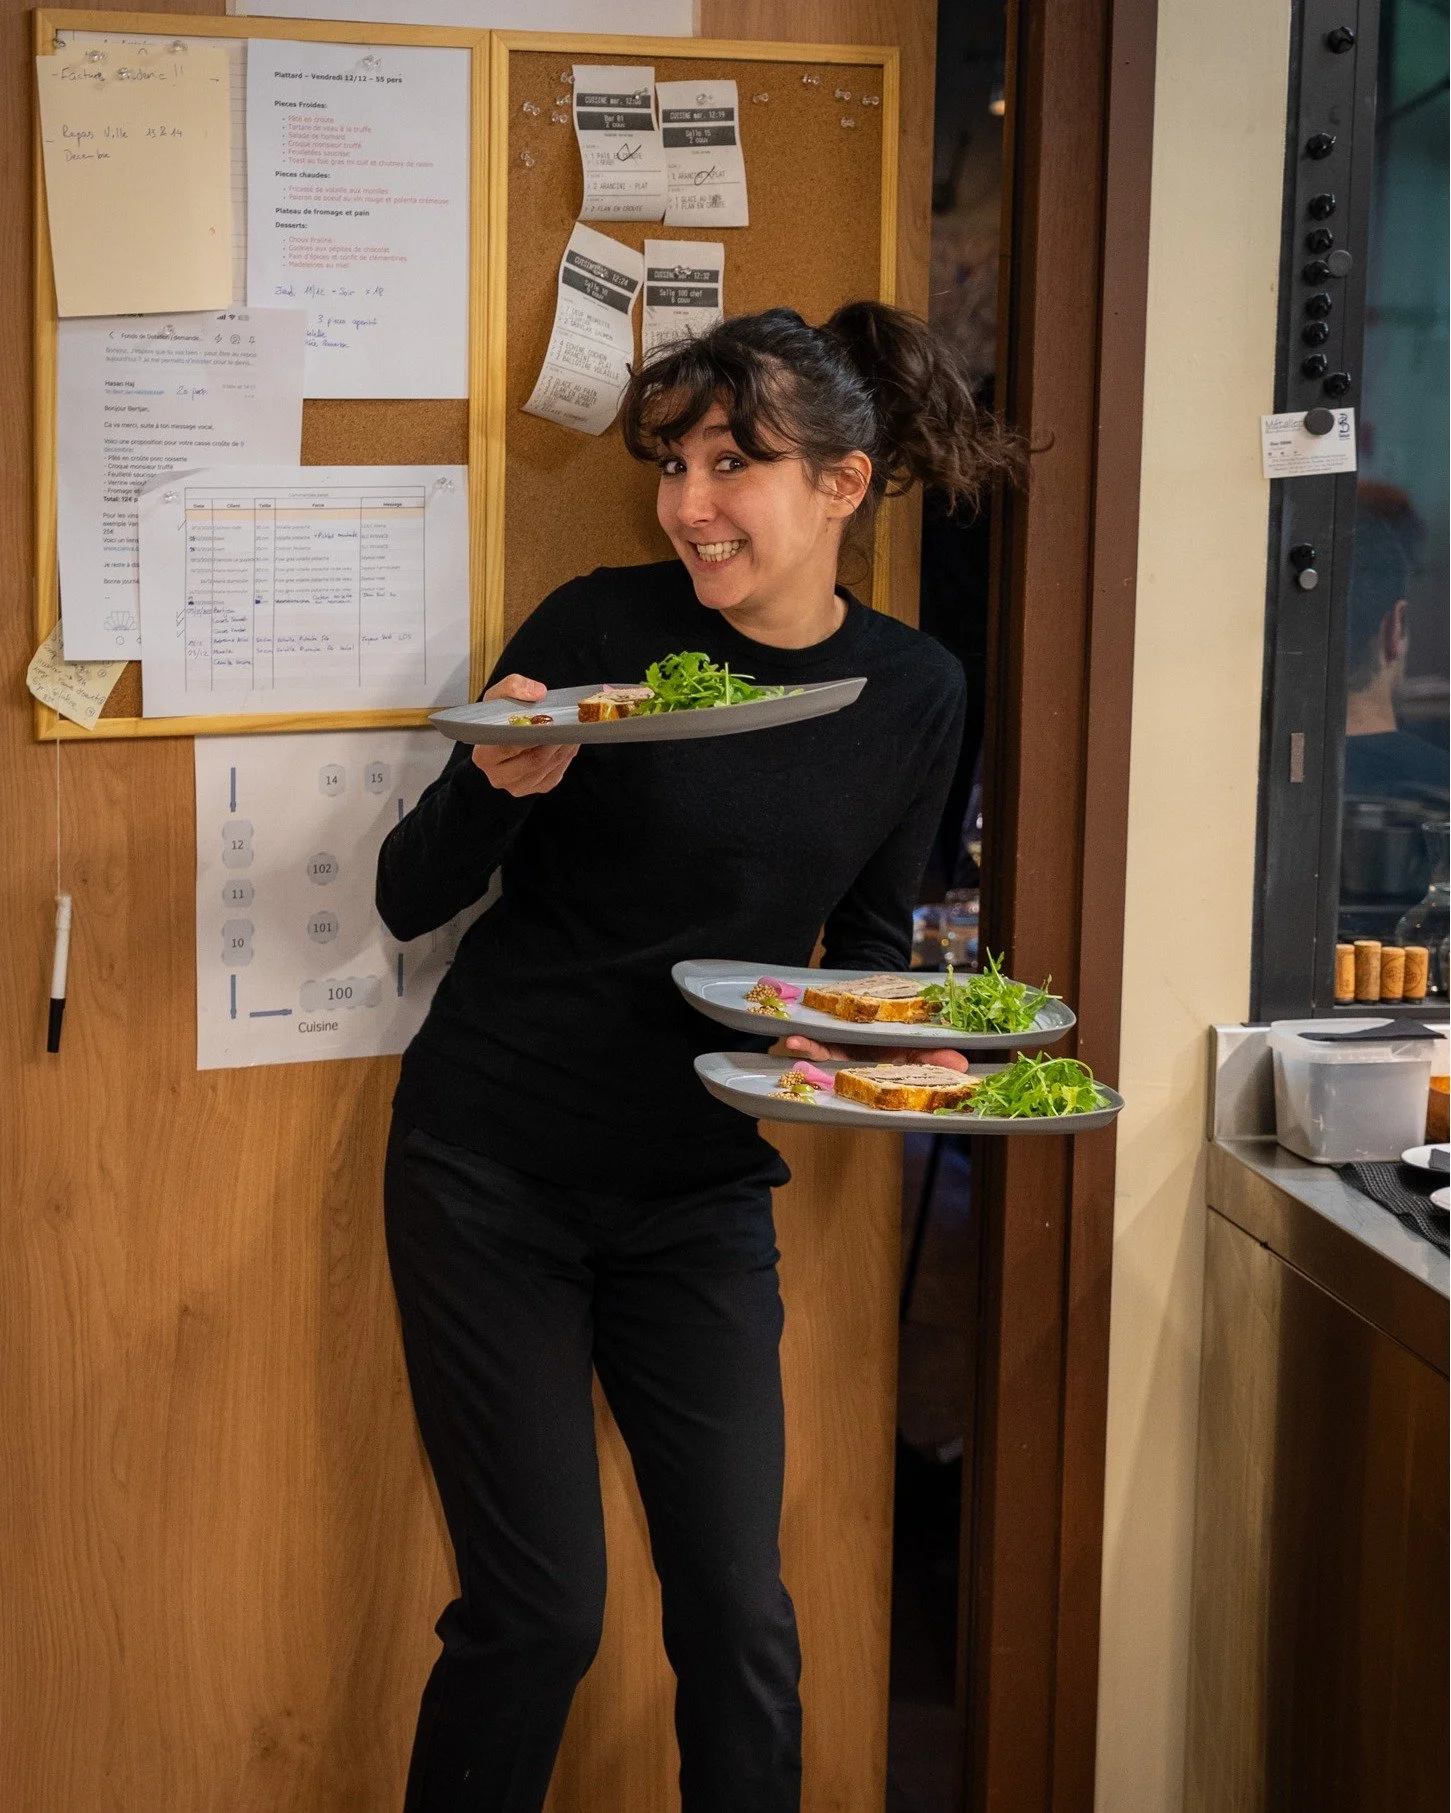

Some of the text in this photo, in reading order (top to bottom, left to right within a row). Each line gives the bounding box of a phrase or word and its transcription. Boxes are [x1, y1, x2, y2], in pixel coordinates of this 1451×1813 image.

[274, 71, 402, 85] Plattard Vendredi 12/12 55 pers
[274, 100, 328, 109] Pieces Froides:
[584, 96, 608, 105] CUISINE
[669, 111, 691, 120] CUISINE
[275, 171, 330, 179] Pieces chaudes:
[275, 208, 370, 219] Plateau de fromage et pain
[275, 222, 308, 230] Desserts:
[325, 774, 338, 785] 14
[371, 772, 383, 784] 15
[231, 839, 244, 850] 12
[312, 863, 332, 874] 102
[231, 889, 244, 899] 11
[313, 922, 332, 933] 101
[232, 938, 244, 949] 10
[327, 987, 353, 1000] 100
[298, 1021, 339, 1033] Cuisine
